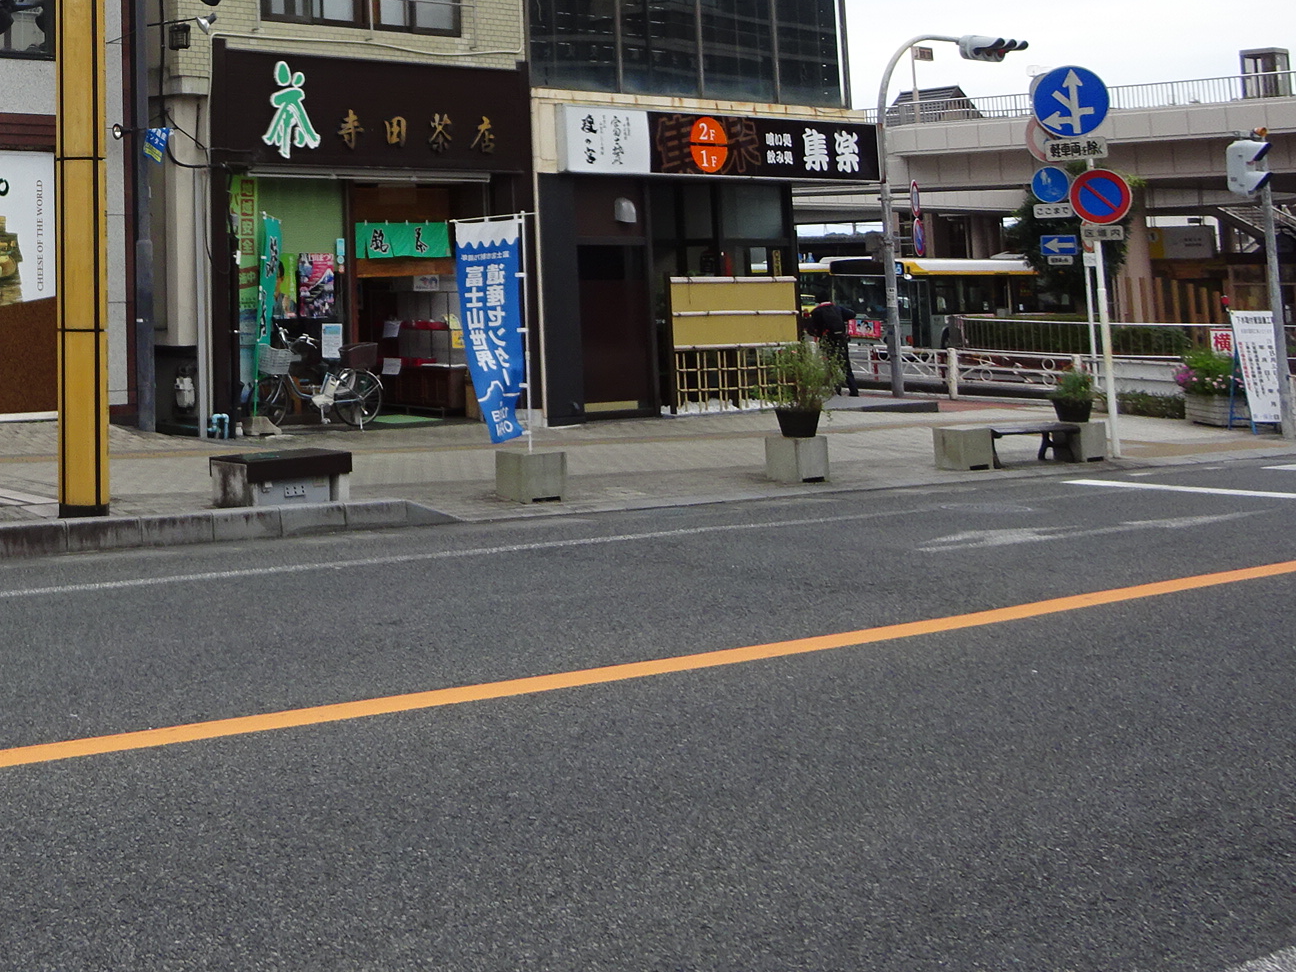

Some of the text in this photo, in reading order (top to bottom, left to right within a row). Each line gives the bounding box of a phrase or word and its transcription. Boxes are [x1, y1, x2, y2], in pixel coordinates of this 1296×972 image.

[336, 108, 496, 155] 寺田茶店
[698, 122, 716, 141] 2F
[765, 131, 793, 147] 喰い処
[766, 149, 794, 165] 飲み処
[802, 127, 860, 174] 集楽
[1049, 140, 1103, 158] 軽車両を除く
[700, 149, 718, 168] 1F
[1036, 206, 1069, 216] ここまで
[1084, 228, 1122, 238] 区域内
[37, 241, 44, 253] OF
[1213, 332, 1232, 353] 横
